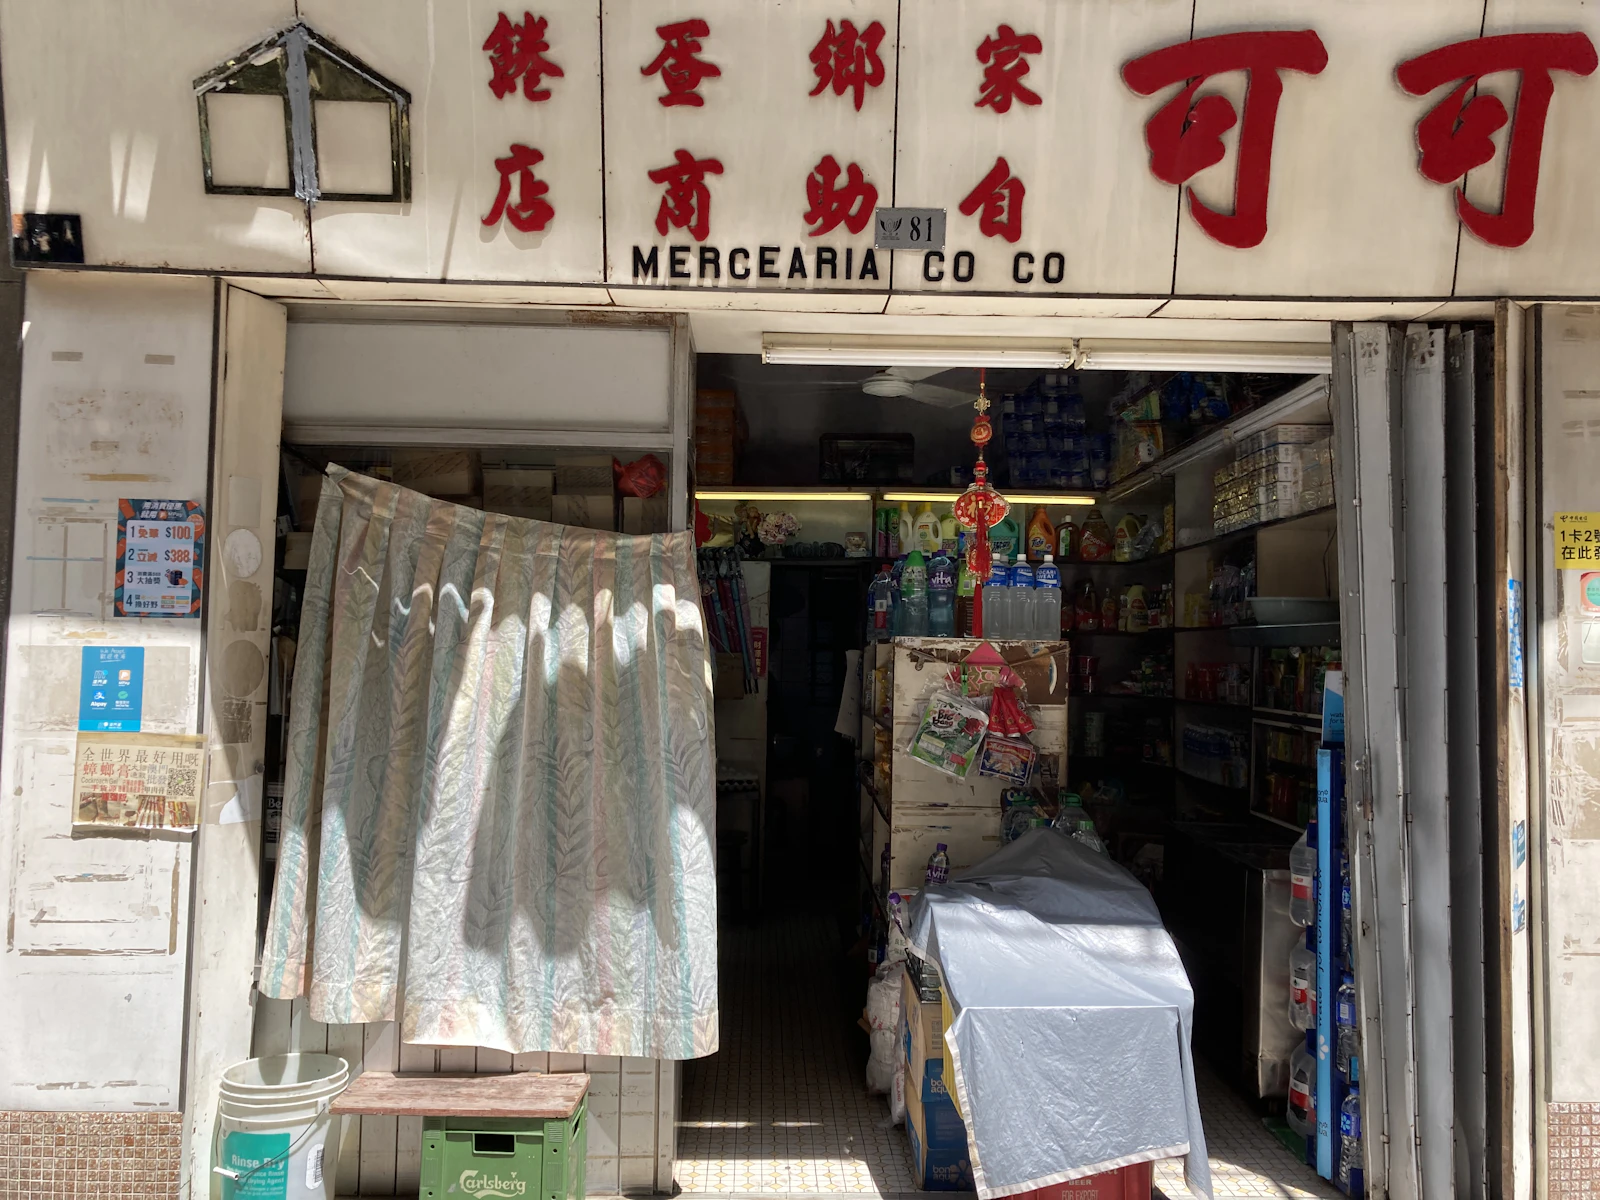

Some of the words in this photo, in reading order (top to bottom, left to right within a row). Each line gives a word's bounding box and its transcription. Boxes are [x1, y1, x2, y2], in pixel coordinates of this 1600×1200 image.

[910, 216, 932, 242] 81
[633, 246, 879, 281] MERCEARIA
[923, 251, 975, 283] CO
[1013, 252, 1065, 284] CO
[165, 525, 191, 540] $100
[128, 548, 135, 561] 2
[164, 549, 190, 563] $388
[931, 571, 953, 586] vita
[930, 1086, 948, 1094] aqu
[231, 1154, 260, 1168] Rinse
[458, 1169, 527, 1196] Carlsberg
[1075, 1189, 1099, 1200] EXPORT
